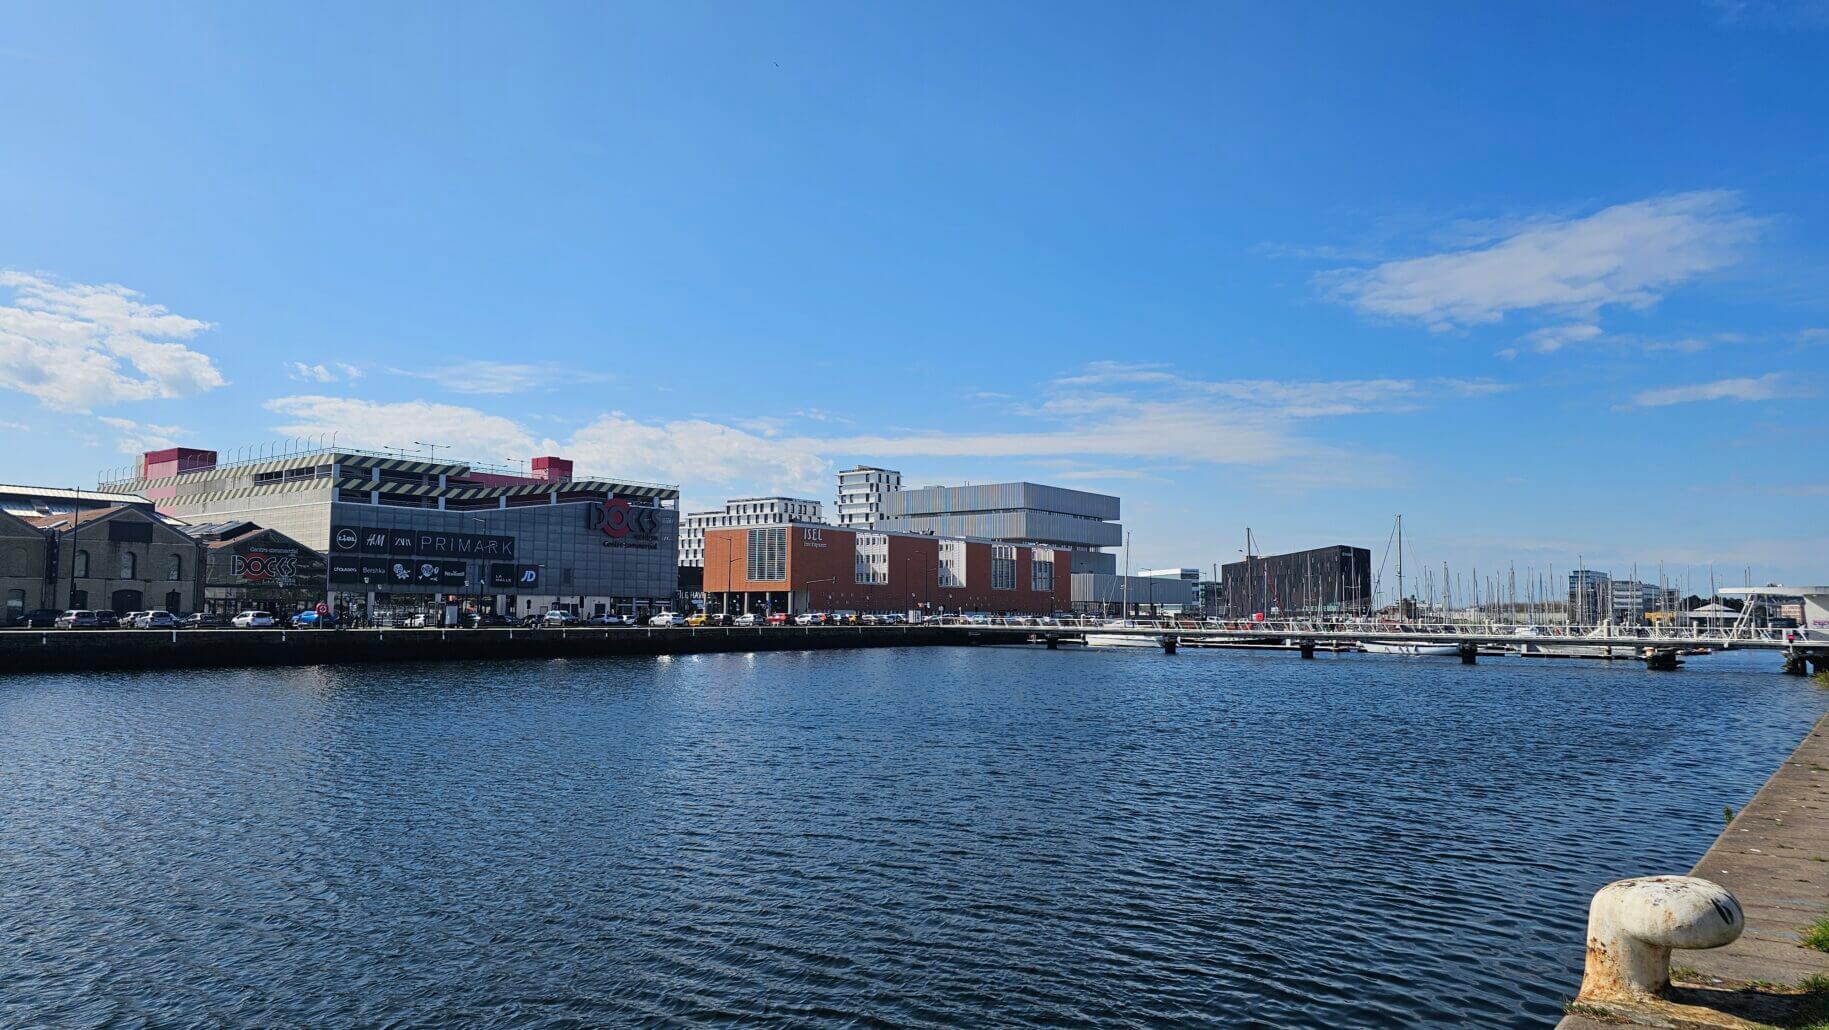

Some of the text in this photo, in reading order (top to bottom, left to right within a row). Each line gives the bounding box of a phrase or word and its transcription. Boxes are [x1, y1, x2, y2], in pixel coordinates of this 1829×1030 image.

[367, 533, 385, 547] H&M
[804, 527, 822, 541] ISEL
[420, 536, 513, 555] PRIMARK
[230, 555, 298, 577] DOCKS
[520, 570, 536, 582] JD
